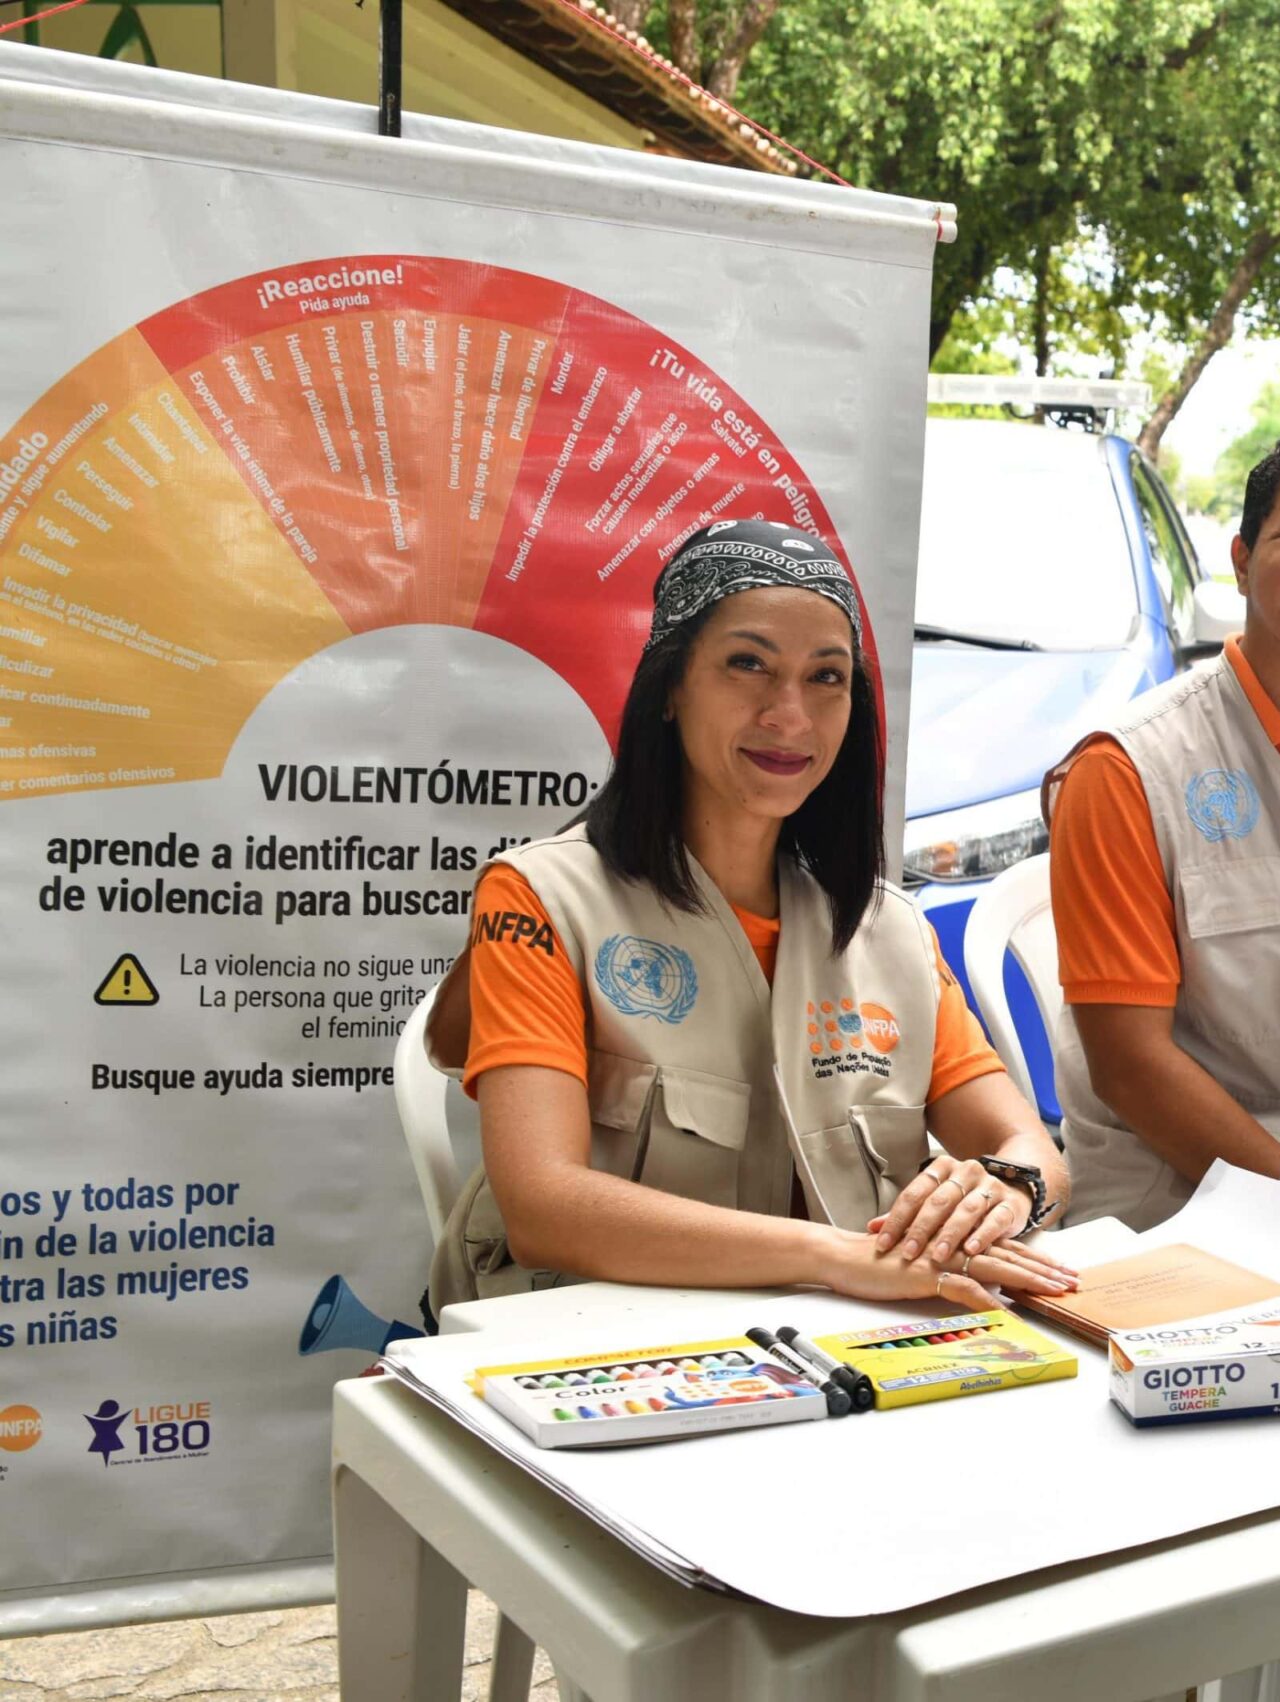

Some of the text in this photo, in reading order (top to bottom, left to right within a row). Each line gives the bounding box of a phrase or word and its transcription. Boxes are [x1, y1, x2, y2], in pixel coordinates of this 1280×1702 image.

[257, 265, 403, 309] ¡Reaccione!
[300, 292, 370, 314] Pida ayuda
[322, 325, 341, 364] Privar
[393, 319, 409, 368] Sacudir
[422, 320, 438, 372] Empujar
[457, 324, 472, 357] Jalar
[222, 355, 255, 405] Prohibir
[250, 345, 276, 382] Aislar
[551, 352, 574, 395] Morder
[285, 333, 341, 473] Humillar públicamente
[510, 339, 546, 441] Privar de libertad
[469, 330, 512, 521] Amenazar hacer daño hijos
[588, 386, 643, 473] Obligar a abortar
[649, 349, 686, 380] ¡Tu
[686, 373, 724, 412] vida
[723, 410, 763, 450] está
[758, 450, 781, 475] en
[14, 402, 109, 508] y sigue aumentando
[360, 321, 409, 551] Destruir o retener propriedad personal
[452, 443, 463, 454] la
[77, 461, 135, 511] Perseguir
[189, 371, 226, 421] Exponer
[221, 418, 234, 435] la
[229, 430, 250, 461] vida
[270, 498, 286, 515] de
[281, 512, 295, 528] la
[288, 526, 318, 564] pareja
[505, 366, 608, 582] Impedir la protección contra el embarazo
[585, 412, 678, 533] Forzar actos sexuales que
[603, 421, 688, 535] causen molestias o asco
[53, 489, 112, 533] Controlar
[597, 452, 721, 581] Amenazar con objetos o armas
[658, 481, 746, 560] Amenaza de muerte
[36, 515, 80, 548] Vigilar
[18, 544, 73, 577] Difamar
[3, 576, 140, 636] Invadir la privacidad
[30, 693, 151, 719] continuadamente
[29, 744, 97, 758] ofensivas
[19, 766, 176, 791] comentarios ofensivos
[46, 832, 200, 873] aprende
[211, 843, 232, 870] a
[245, 835, 420, 871] identificar
[431, 836, 477, 871] las
[38, 875, 472, 925] de violencia para buscar
[180, 953, 207, 976] La
[214, 953, 316, 978] violencia
[323, 957, 351, 978] no
[358, 954, 415, 983] sigue
[199, 984, 426, 1013] La persona que grita
[301, 1016, 321, 1038] el
[91, 1061, 394, 1096] Busque ayuda siempre
[811, 1052, 857, 1067] Fundo de
[815, 1062, 869, 1079] das Nações
[52, 1189, 72, 1222] y
[81, 1177, 174, 1212] todas
[185, 1181, 240, 1215] por
[35, 1216, 275, 1258] de la violencia
[57, 1267, 106, 1299] las
[117, 1262, 249, 1301] mujeres
[27, 1310, 118, 1346] niñas
[876, 1326, 905, 1338] GIZ
[911, 1321, 934, 1332] DE
[1125, 1325, 1239, 1342] GIOTTO
[555, 1385, 628, 1399] Color
[1144, 1363, 1246, 1390] GIOTTO
[1162, 1385, 1227, 1401] TEMPERA
[134, 1402, 211, 1424] LIGUE
[1169, 1399, 1220, 1412] GUACHE
[134, 1419, 210, 1455] 180
